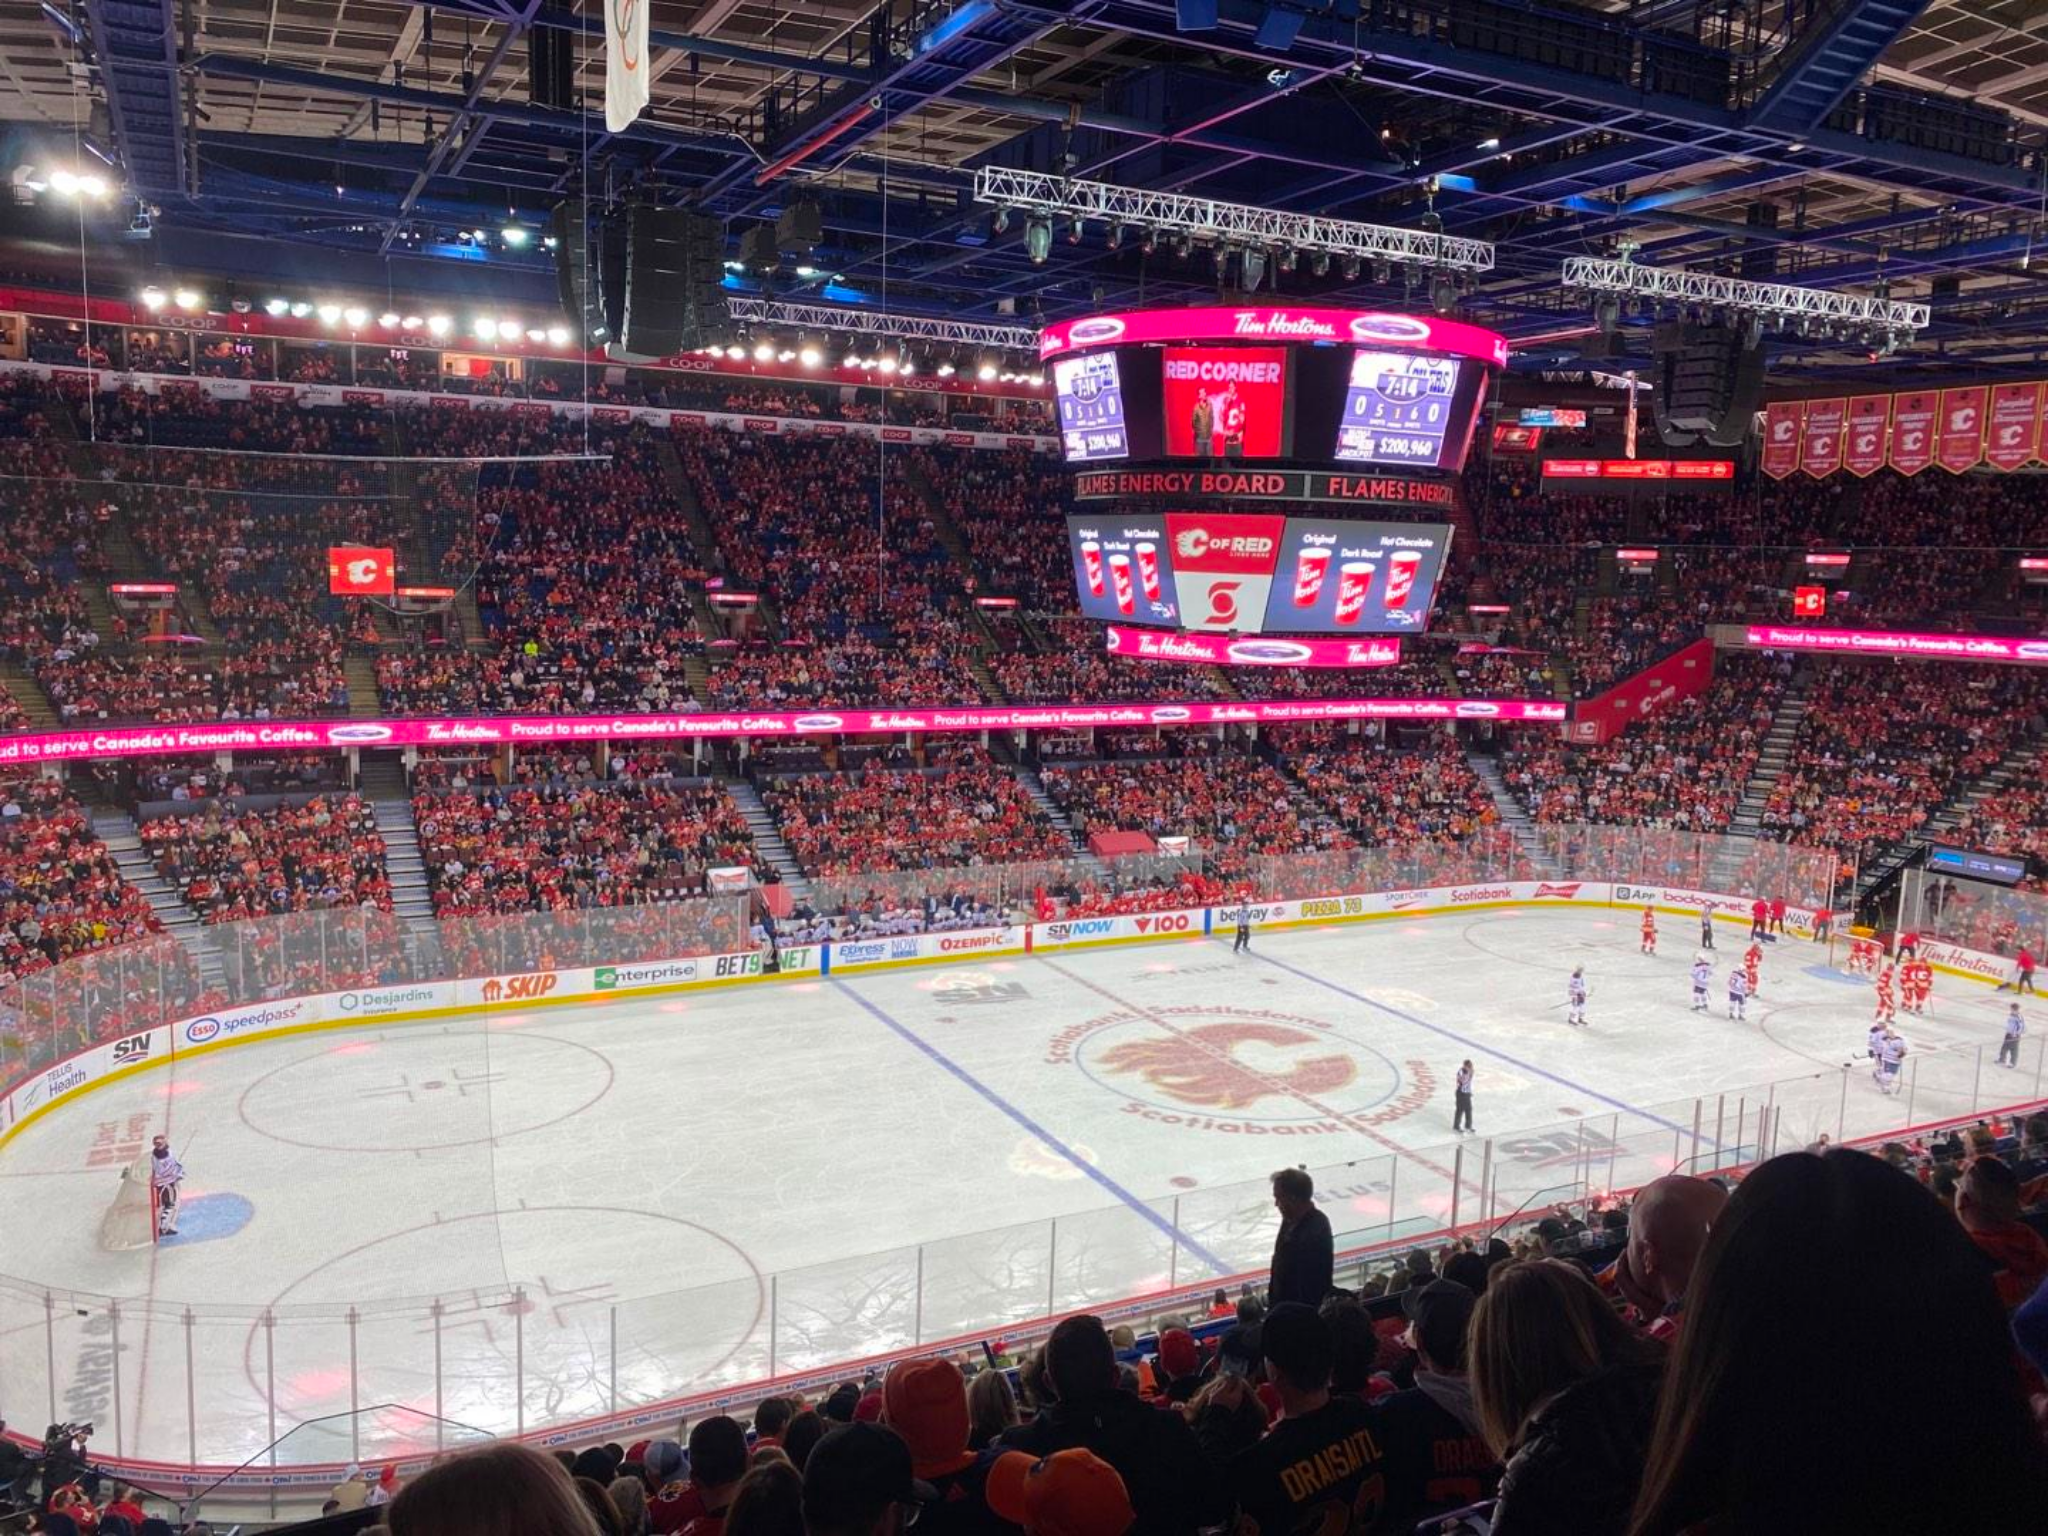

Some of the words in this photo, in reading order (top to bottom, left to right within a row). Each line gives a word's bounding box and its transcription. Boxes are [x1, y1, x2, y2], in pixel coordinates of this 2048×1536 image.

[159, 315, 217, 329] CO-OP
[1234, 312, 1266, 335] Tim
[669, 357, 715, 371] CO-OP
[1165, 361, 1198, 380] RED
[1200, 361, 1281, 384] CORNER
[1385, 376, 1419, 397] 7:14
[1355, 395, 1367, 415] 0
[1375, 403, 1385, 417] 5
[1428, 403, 1440, 423] 0
[1379, 437, 1433, 457] $200,960
[1120, 473, 1195, 493] ENERGY
[1201, 473, 1285, 494] BOARD
[1329, 477, 1404, 500] FLAMES
[1209, 539, 1230, 550] OF
[1231, 537, 1273, 552] RED
[1303, 534, 1337, 546] Original
[1139, 635, 1159, 654] Tim
[1770, 631, 1804, 643] Proud
[1805, 632, 1817, 643] to
[934, 714, 966, 726] Proud
[968, 714, 980, 726] to
[982, 715, 1009, 726] serve
[1011, 712, 1060, 725] Canada's
[1061, 711, 1108, 723] Favourite
[1263, 705, 1288, 717] Proud
[1290, 705, 1300, 716] to
[1302, 706, 1324, 716] serve
[1325, 704, 1366, 715] Canada's
[427, 725, 451, 739] Tim
[511, 723, 554, 736] Proud
[556, 723, 570, 735] to
[573, 723, 610, 735] serve
[612, 719, 676, 735] Canada's
[678, 719, 739, 733] Favourite
[742, 717, 787, 731] Coffee.
[23, 741, 39, 755] to
[43, 740, 89, 755] serve
[93, 733, 175, 750] Canada's
[178, 730, 256, 747] Favourite
[259, 728, 318, 743] Coffee.
[1451, 886, 1512, 903] Scotiabank
[1300, 900, 1341, 918] PIZZA
[1343, 898, 1363, 914] 73
[1048, 923, 1071, 937] SN
[1072, 919, 1114, 936] NOW
[1154, 915, 1190, 933] 100
[891, 937, 918, 950] NOW
[1919, 942, 1948, 962] Tim
[1949, 948, 2004, 979] Hortons
[602, 963, 695, 983] enterprise
[504, 973, 557, 1000] SKIP
[363, 989, 434, 1006] Desjardins
[1147, 1003, 1333, 1031] Saddledome
[191, 1025, 216, 1037] Esso
[1044, 1010, 1140, 1065] Scotiabank
[114, 1032, 151, 1060] SN
[47, 1062, 73, 1082] TELUS
[49, 1069, 87, 1097] Health
[1119, 1101, 1339, 1137] Scotiabank
[1313, 1180, 1391, 1203] ELUS
[1279, 1428, 1384, 1503] DRAISAITL
